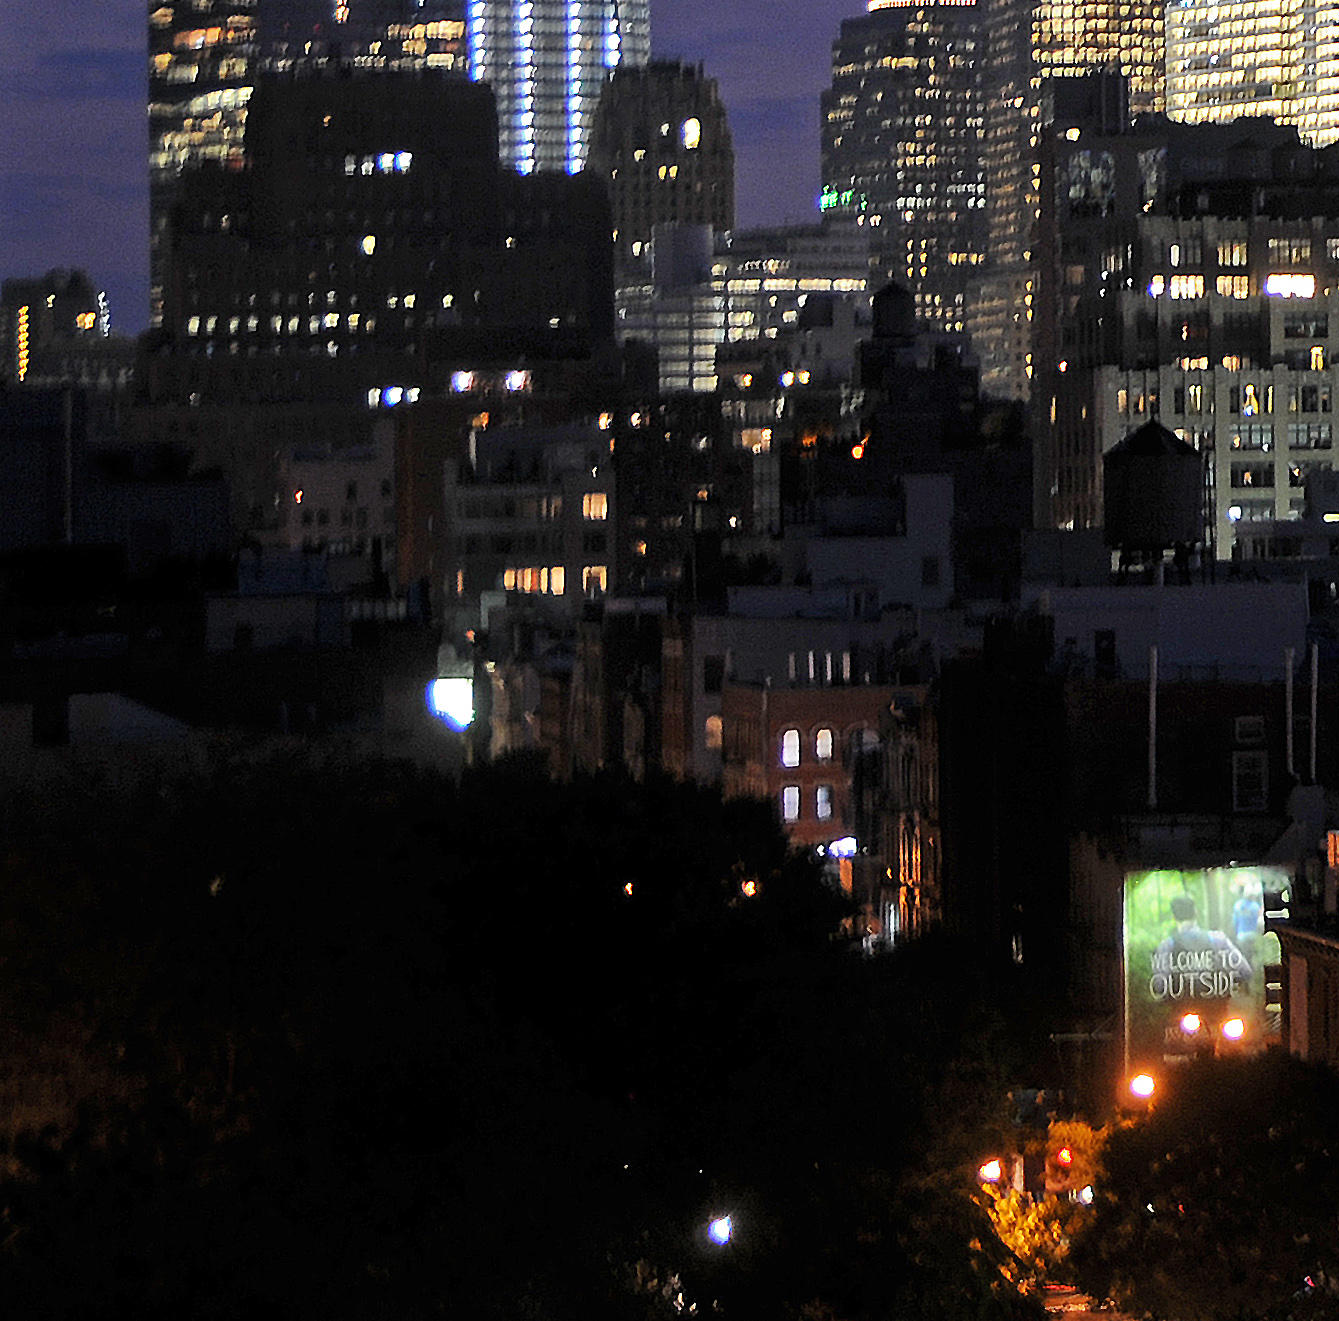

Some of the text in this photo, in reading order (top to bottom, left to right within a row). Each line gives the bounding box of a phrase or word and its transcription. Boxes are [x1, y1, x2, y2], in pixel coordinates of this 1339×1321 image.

[1151, 949, 1241, 972] WELCOME TO
[1149, 971, 1240, 1000] OUTSIDE
